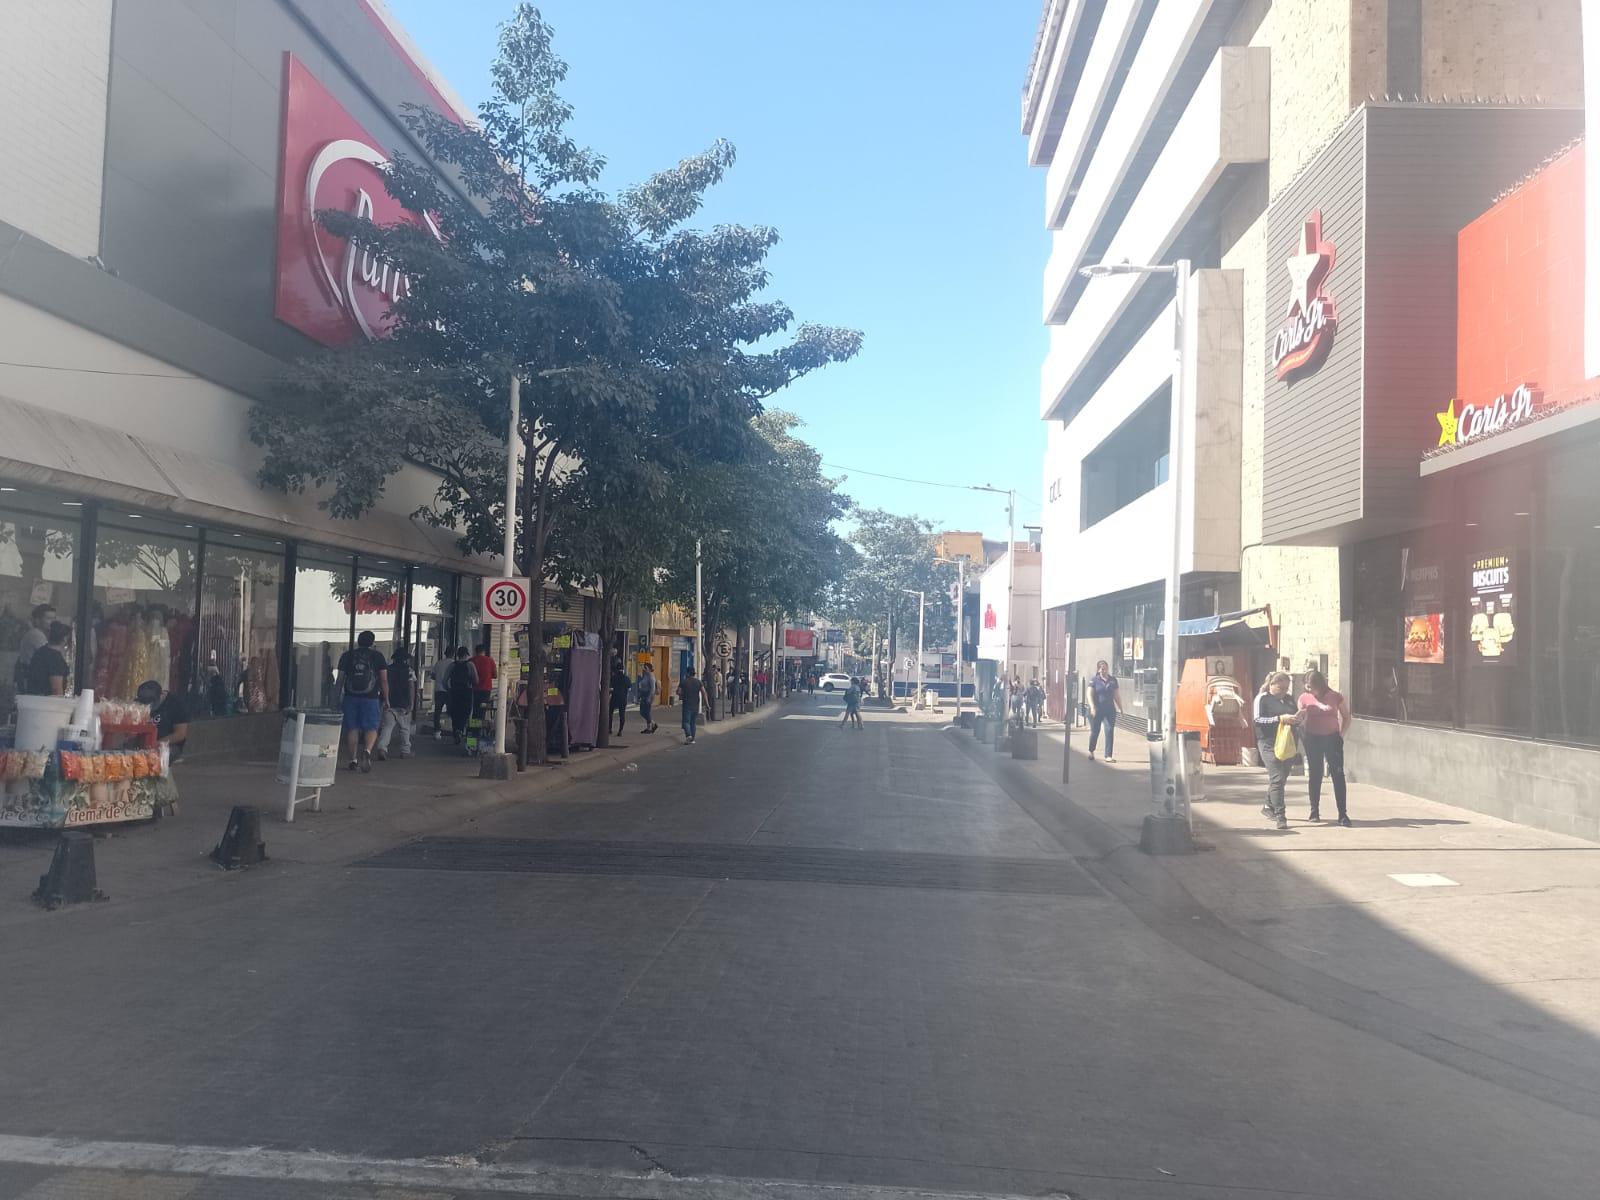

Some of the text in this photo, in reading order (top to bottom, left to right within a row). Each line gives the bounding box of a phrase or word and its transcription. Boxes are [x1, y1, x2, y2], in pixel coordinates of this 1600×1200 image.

[1272, 309, 1305, 368] Carl's
[1457, 394, 1509, 444] Carl's
[1476, 557, 1505, 569] PREMIUM
[1473, 567, 1509, 587] BISCUITS
[495, 590, 518, 607] 30
[69, 807, 102, 823] Crema
[105, 805, 120, 819] de
